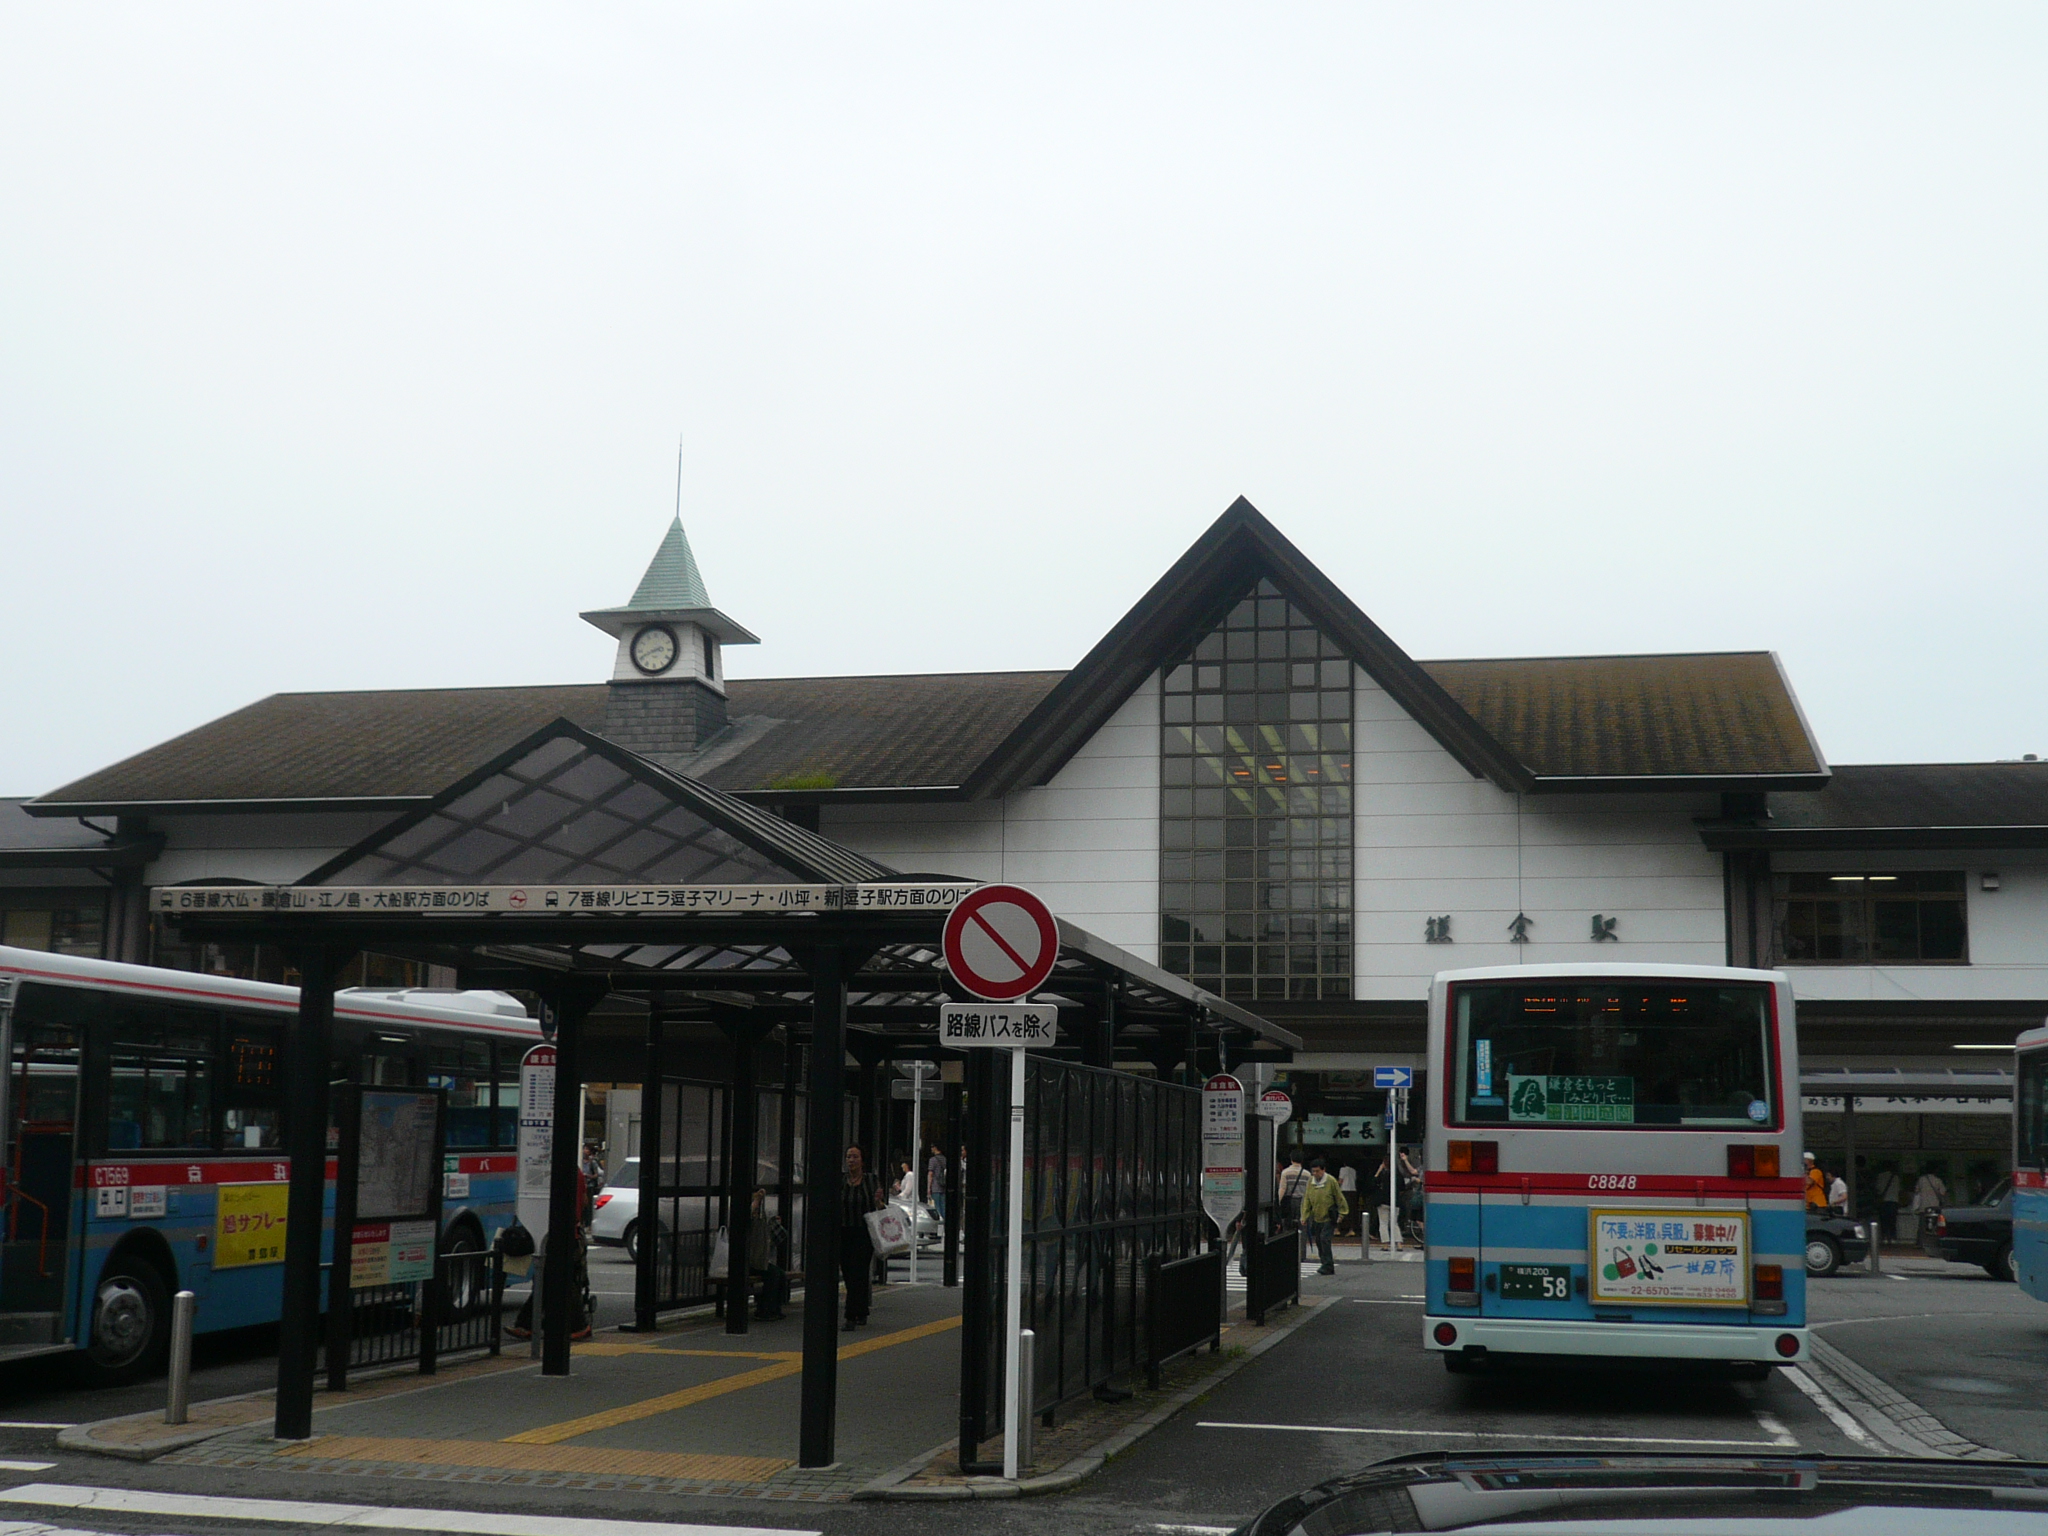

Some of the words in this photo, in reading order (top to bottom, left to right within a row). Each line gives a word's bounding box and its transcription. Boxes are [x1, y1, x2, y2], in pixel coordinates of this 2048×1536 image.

[1424, 912, 1618, 943] 鎌倉駅
[947, 1013, 1050, 1038] 路線バスを除く
[1548, 1077, 1615, 1091] 鎌倉をもっと
[95, 1167, 129, 1185] C7569
[1588, 1175, 1637, 1189] C8848
[1666, 1245, 1737, 1254] リセールショップ
[1631, 1286, 1670, 1296] 22-6570
